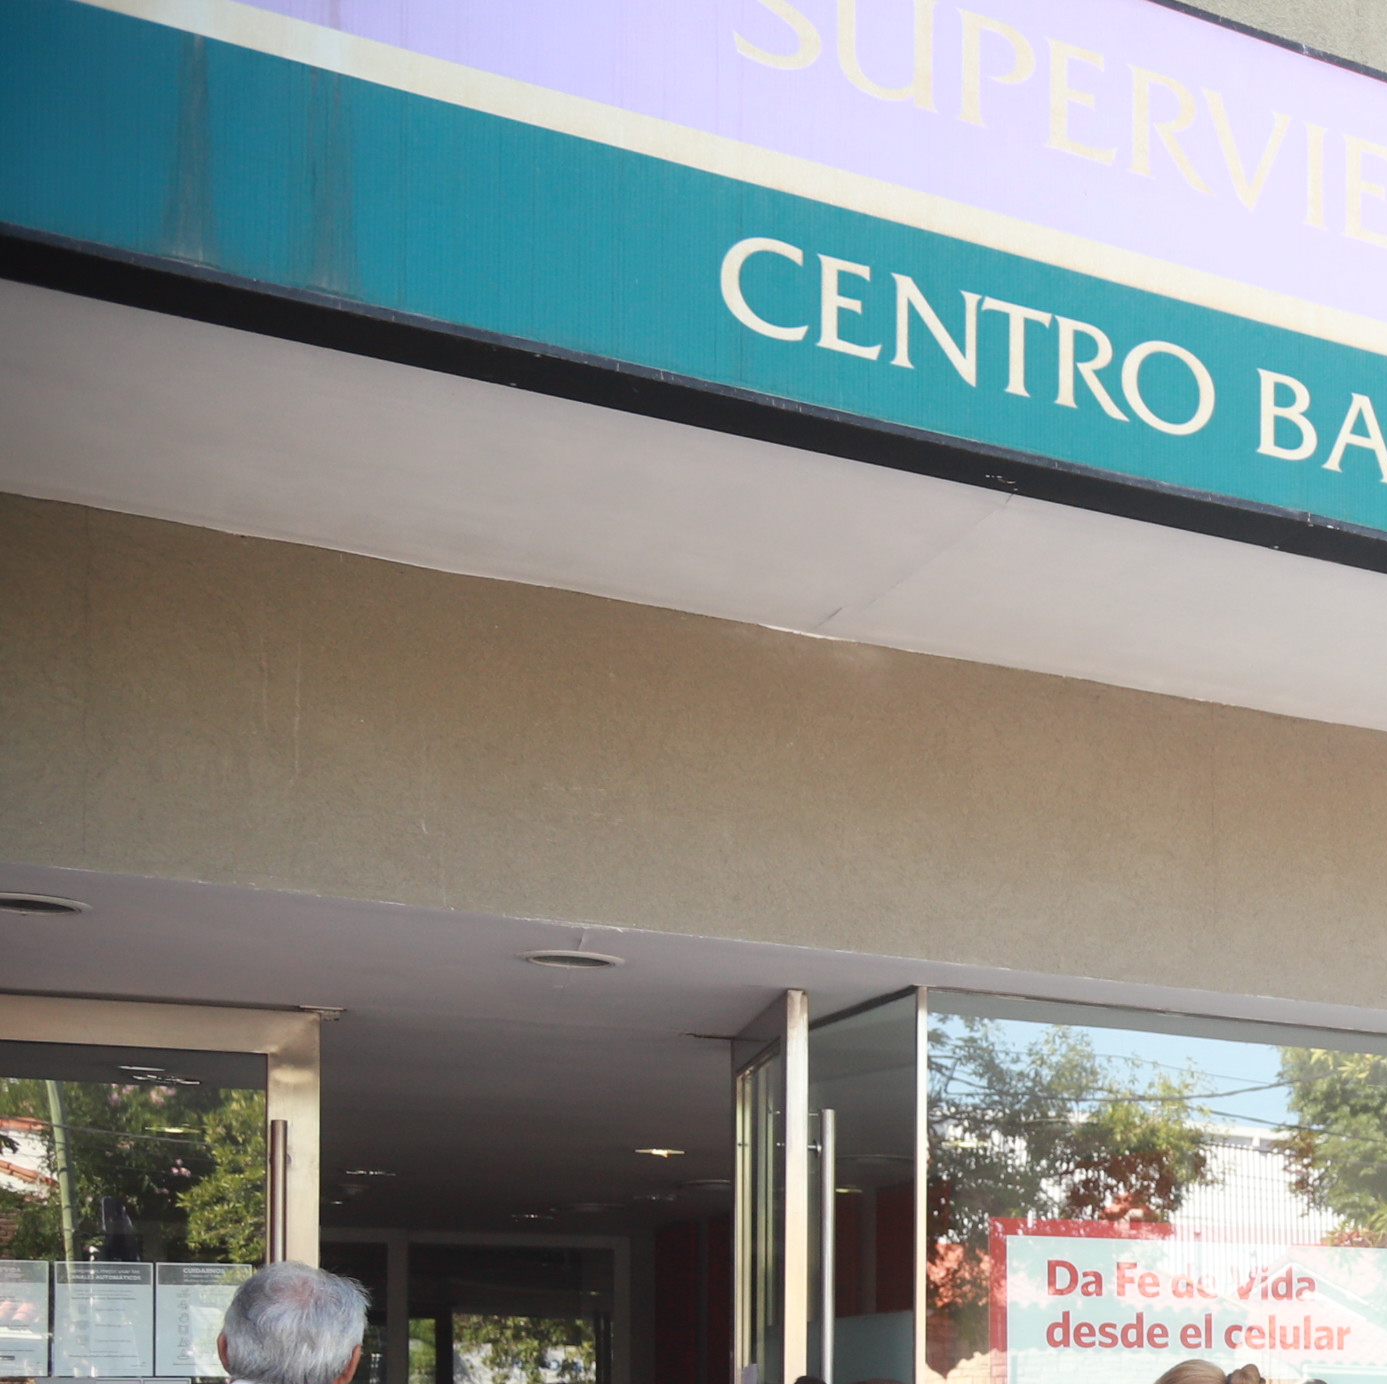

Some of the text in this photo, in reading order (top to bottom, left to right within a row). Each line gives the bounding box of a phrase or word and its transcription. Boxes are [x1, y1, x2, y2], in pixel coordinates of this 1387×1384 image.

[719, 235, 1216, 437] CENTRO
[1046, 1259, 1317, 1301] Da Fe de Vida
[1045, 1310, 1352, 1351] desde el celular
